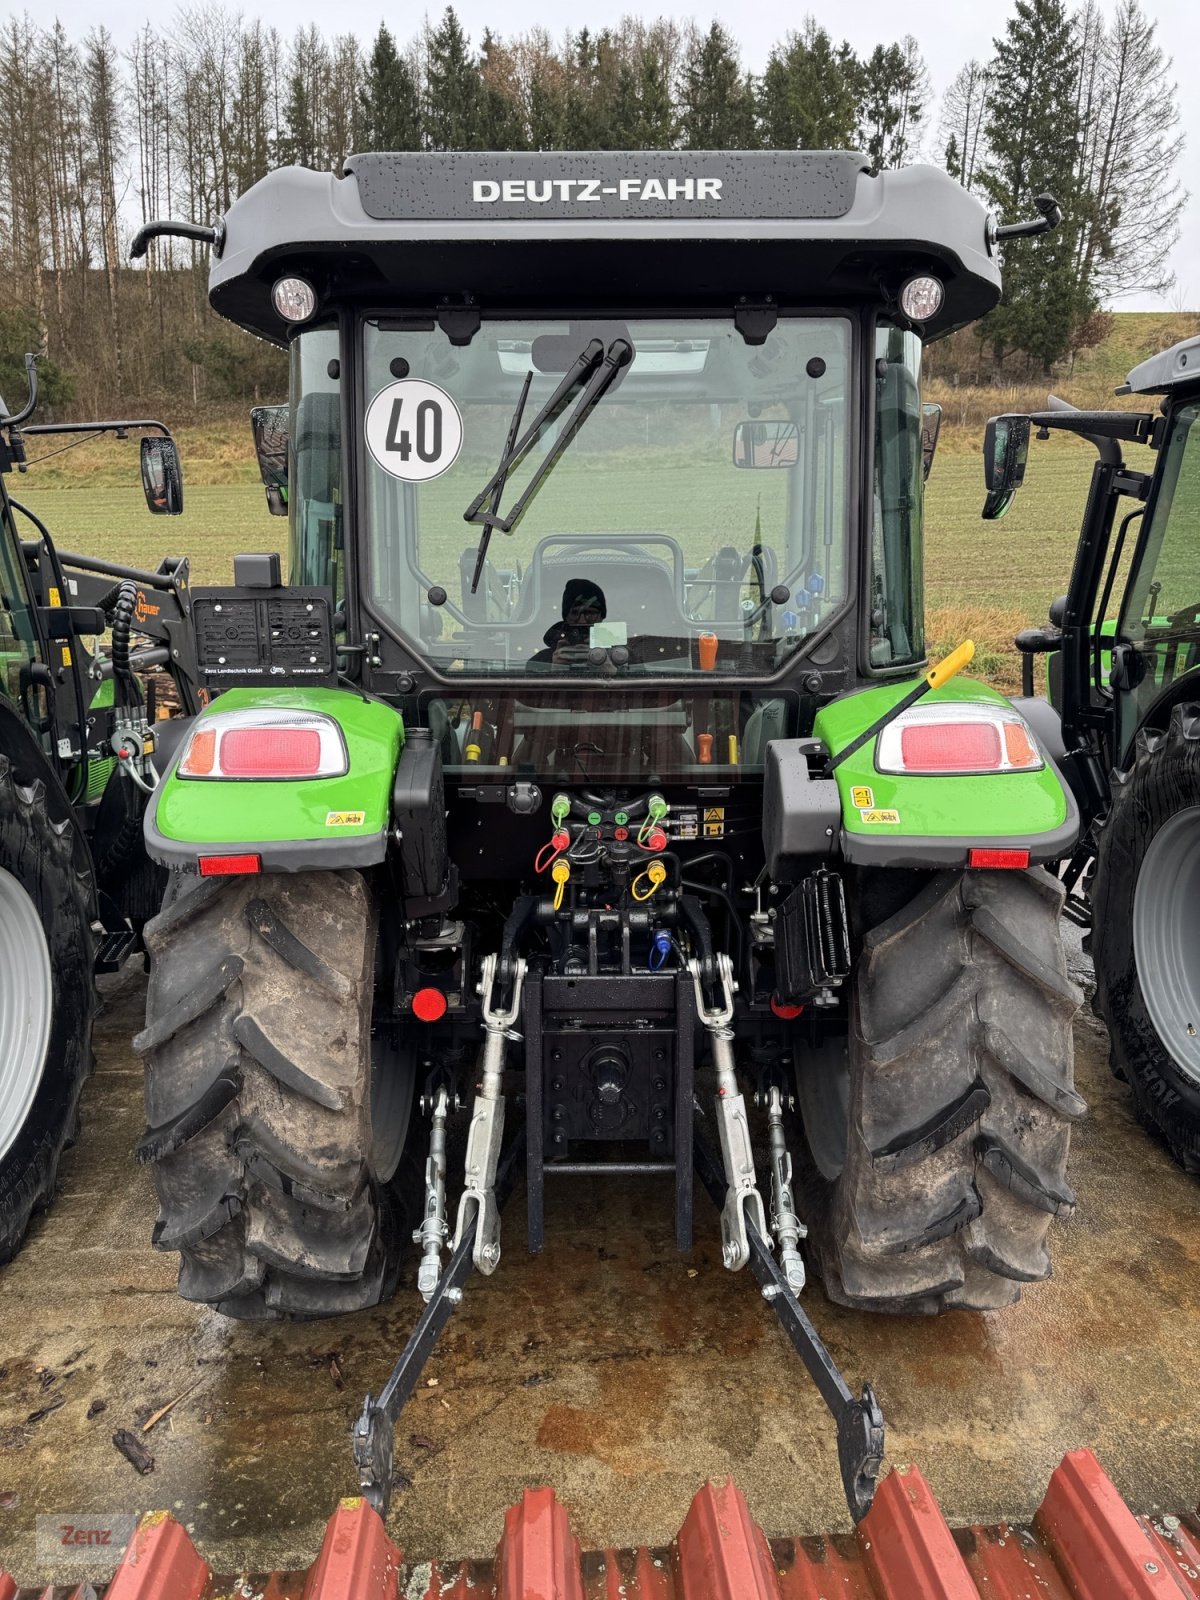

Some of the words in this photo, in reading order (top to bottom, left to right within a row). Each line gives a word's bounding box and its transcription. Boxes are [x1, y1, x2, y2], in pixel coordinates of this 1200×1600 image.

[472, 178, 723, 202] DEUTZ-FAHR
[385, 398, 443, 463] 40
[138, 598, 161, 616] hauer
